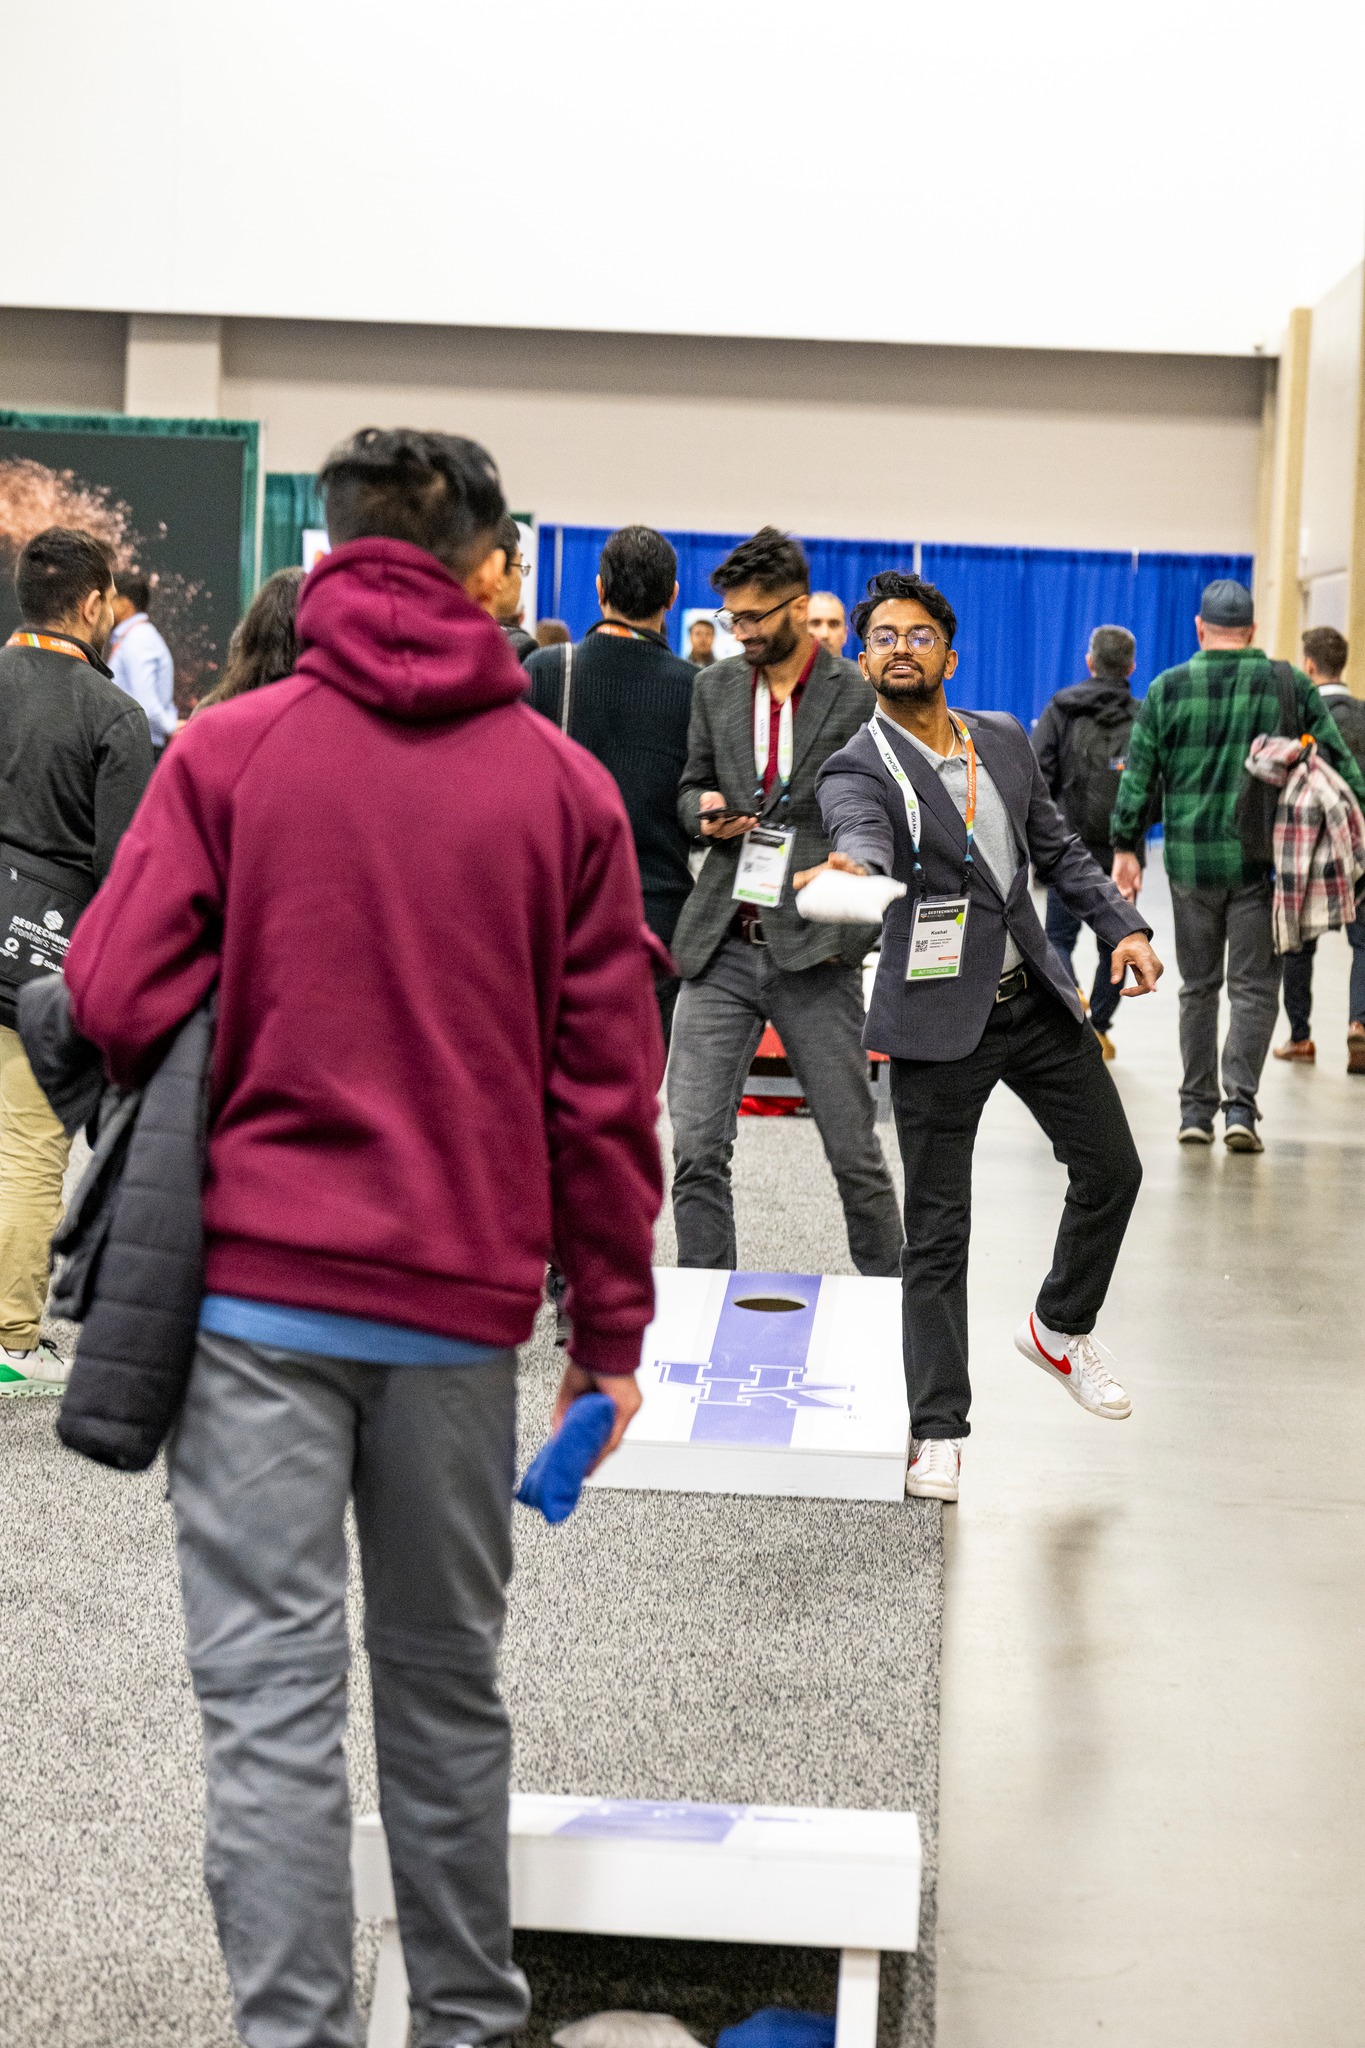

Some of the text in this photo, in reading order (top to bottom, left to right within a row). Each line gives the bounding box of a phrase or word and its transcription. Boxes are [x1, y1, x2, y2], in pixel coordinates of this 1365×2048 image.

[884, 752, 899, 773] SOLMAX
[8, 923, 50, 948] Frontiers
[12, 915, 71, 948] GEOTECHNIC
[43, 959, 65, 974] SOLM
